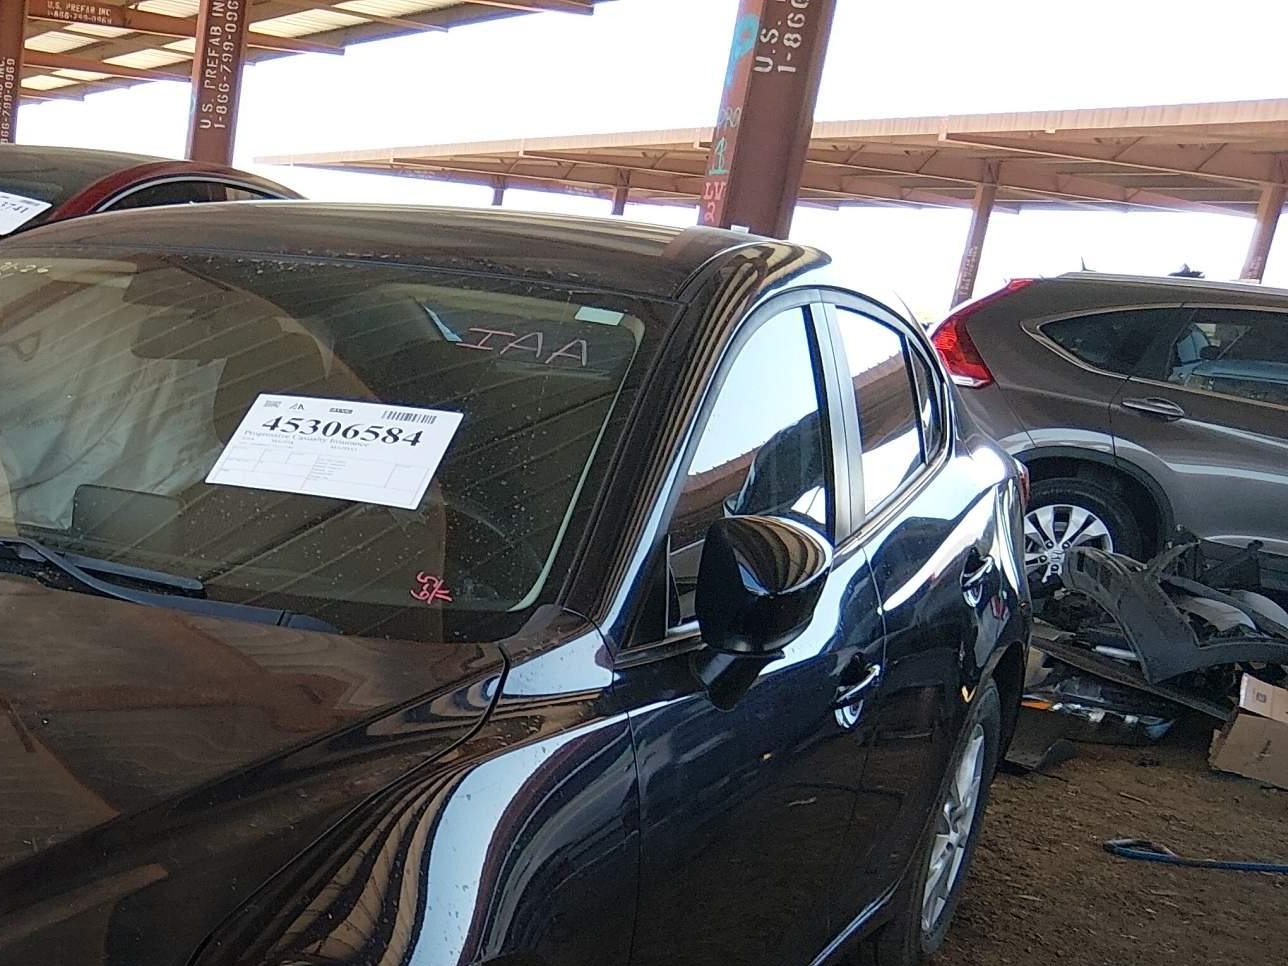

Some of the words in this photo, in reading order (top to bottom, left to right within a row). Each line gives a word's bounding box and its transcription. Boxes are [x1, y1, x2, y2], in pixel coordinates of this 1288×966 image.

[203, 25, 223, 90] PREFAB
[753, 19, 783, 73] U.S.
[455, 327, 588, 367] IAA
[262, 415, 424, 447] 45306584
